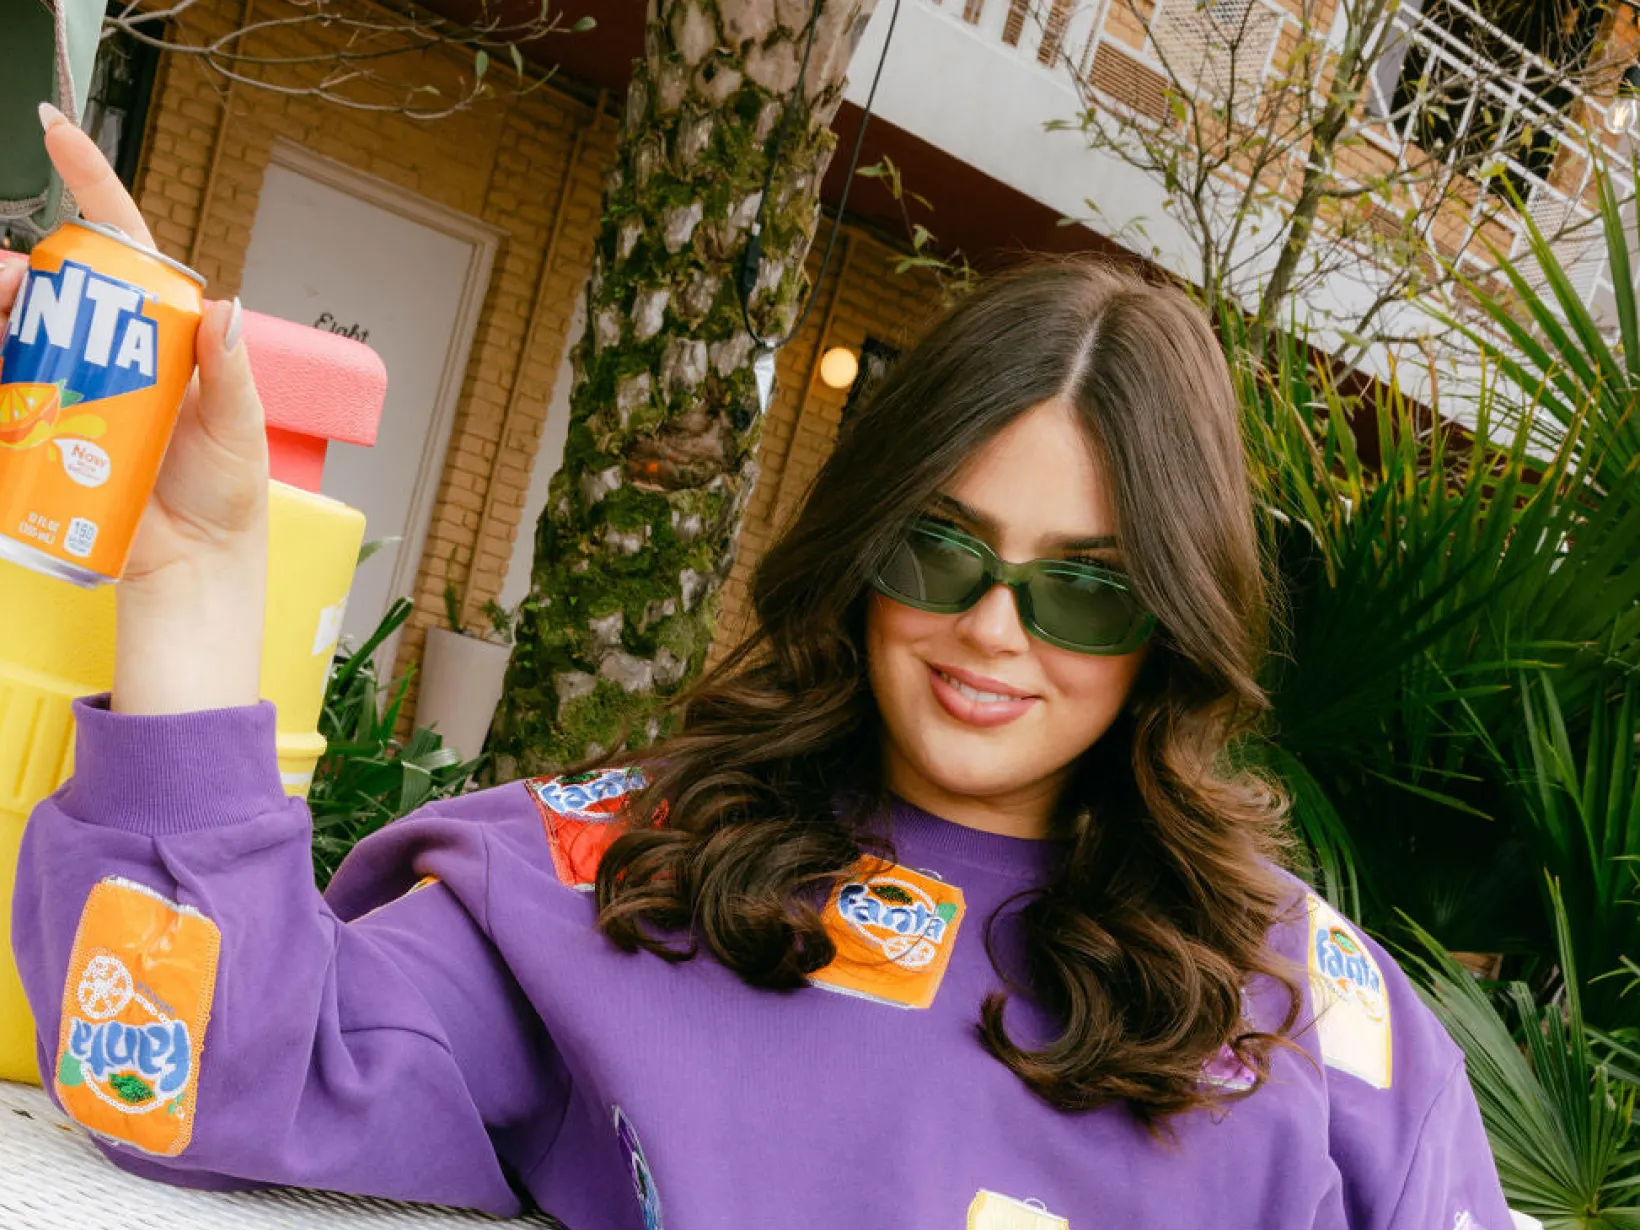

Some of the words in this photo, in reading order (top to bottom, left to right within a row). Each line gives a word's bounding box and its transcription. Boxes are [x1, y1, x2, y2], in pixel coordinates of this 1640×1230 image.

[839, 884, 947, 942] Fanta
[1316, 928, 1380, 992] Fanta
[70, 1018, 190, 1097] Fanta
